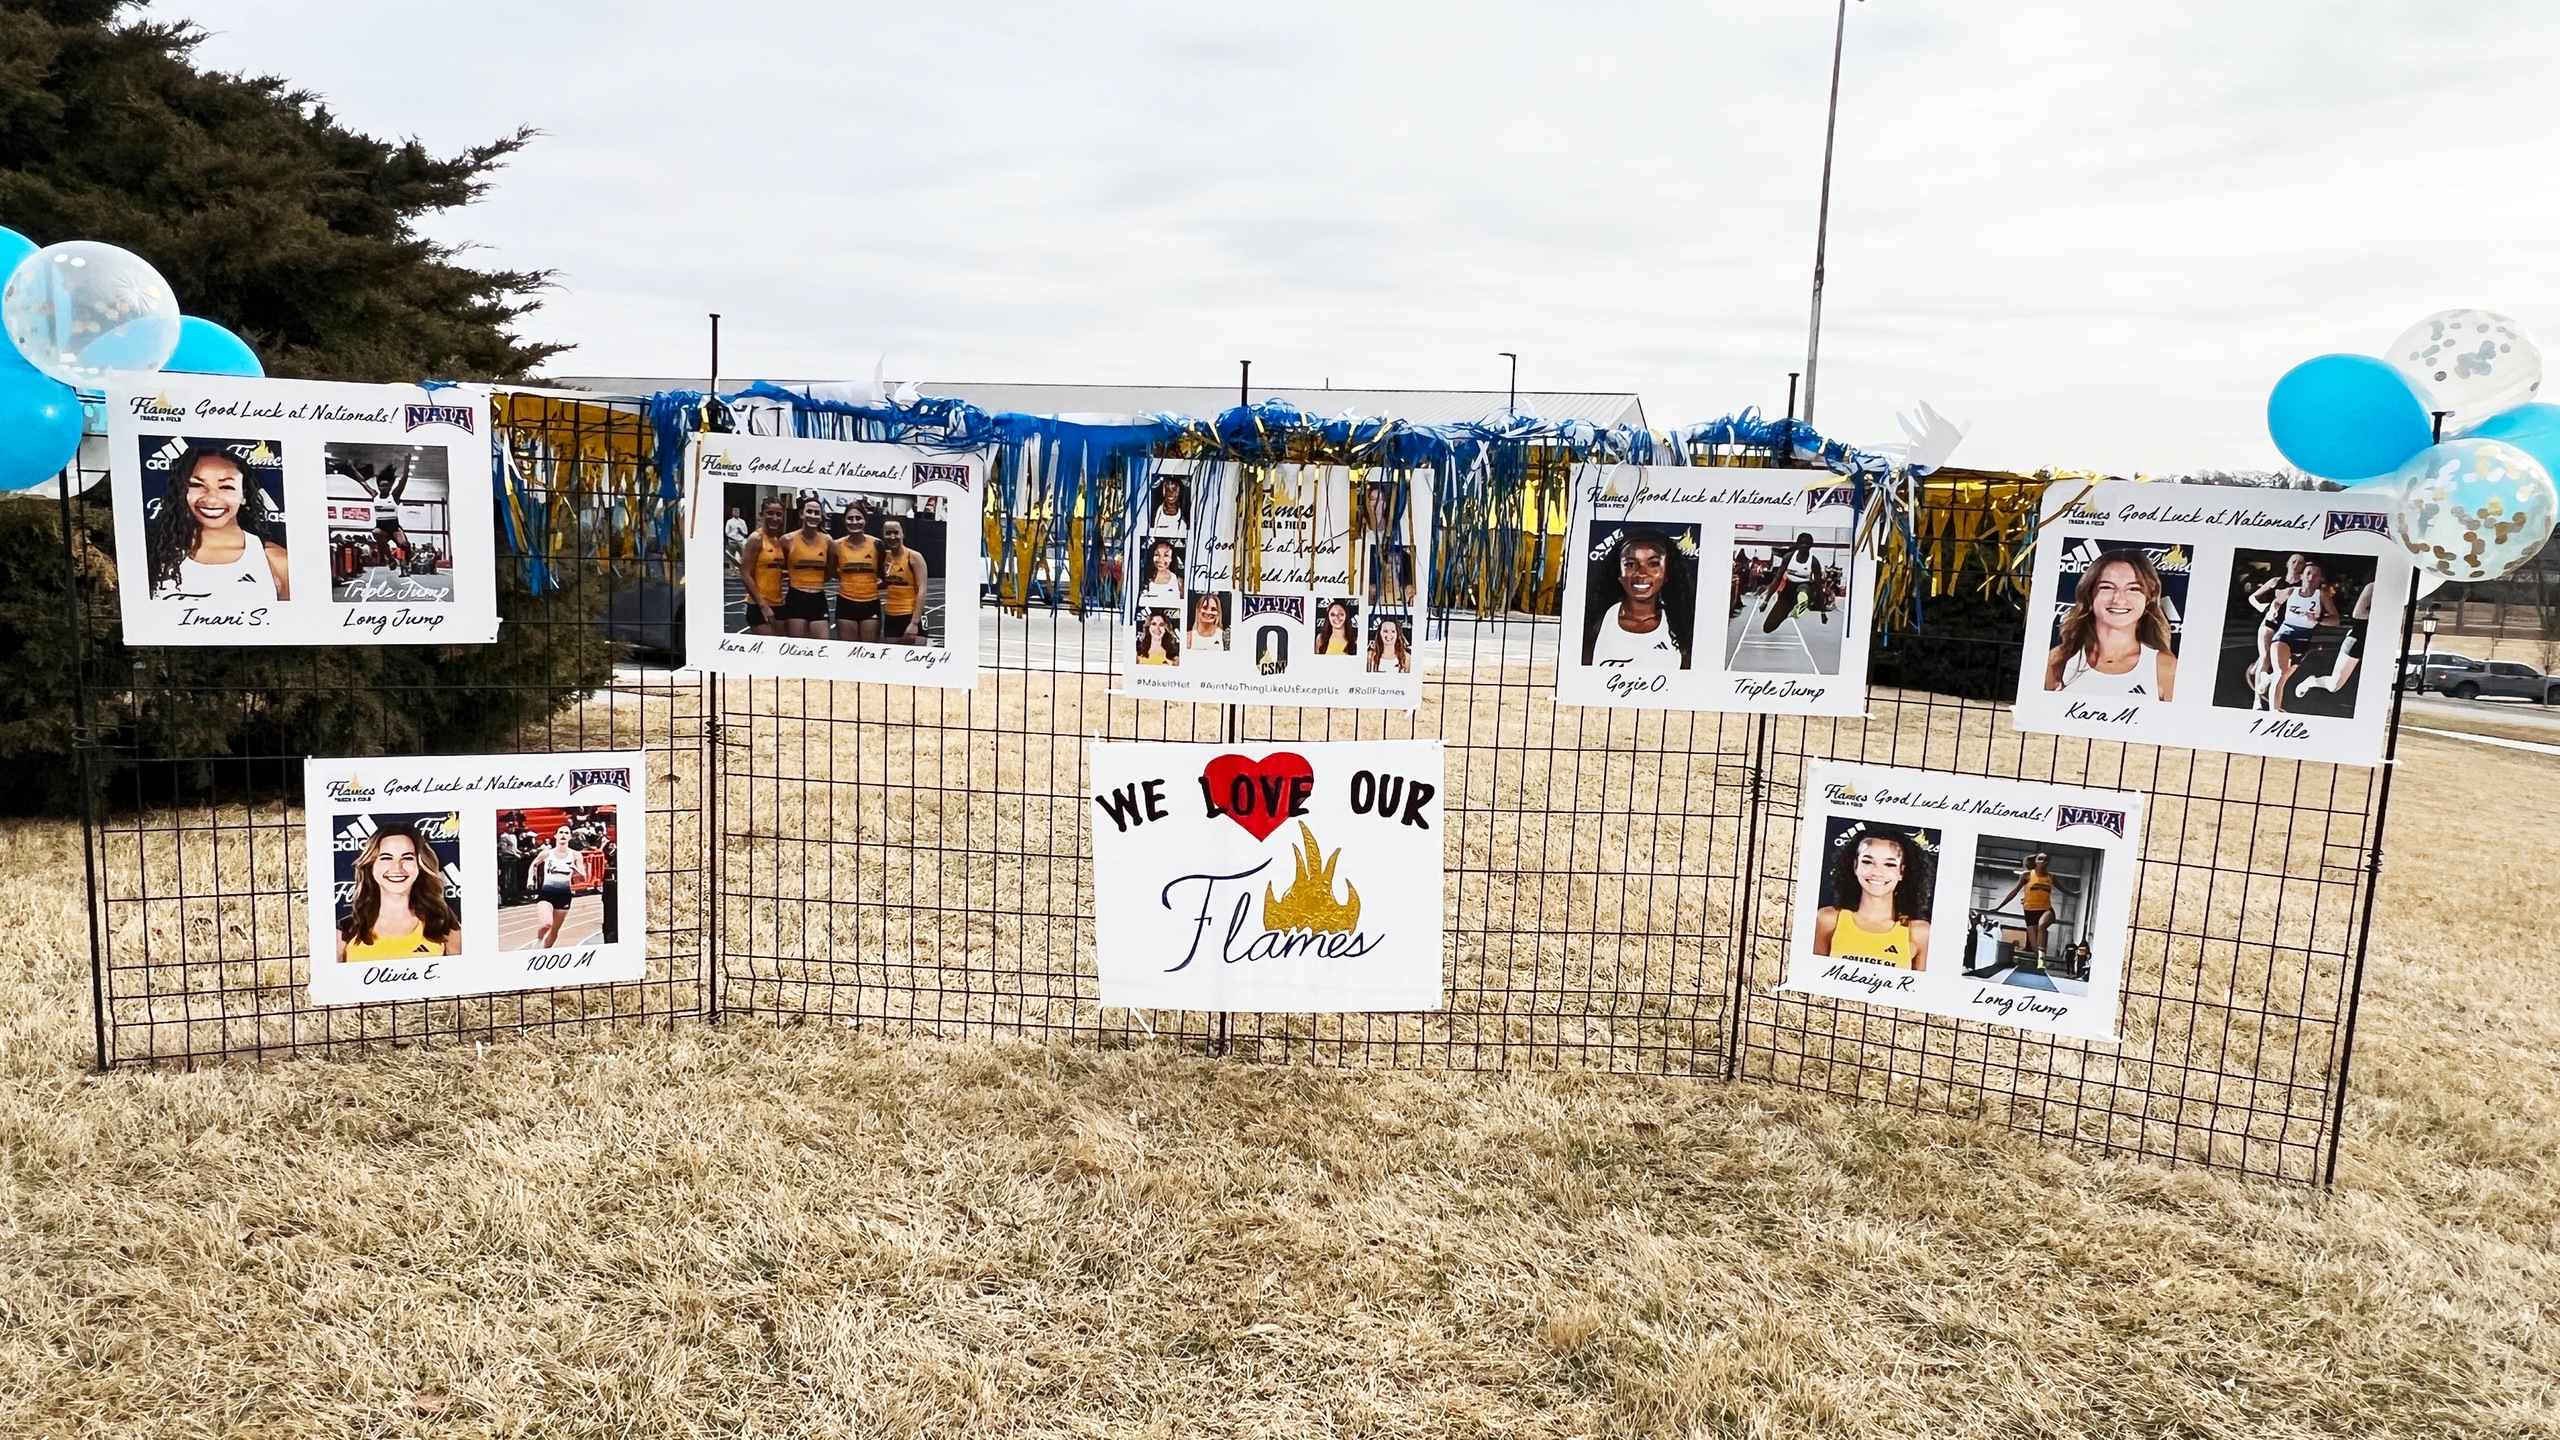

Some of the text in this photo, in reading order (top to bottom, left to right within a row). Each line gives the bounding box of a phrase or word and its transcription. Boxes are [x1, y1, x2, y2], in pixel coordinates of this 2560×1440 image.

[130, 396, 186, 416] Flames
[195, 398, 398, 425] Good Luck at Nationals!
[405, 404, 473, 431] NAIA
[748, 456, 782, 474] Good
[782, 458, 816, 474] Luck
[818, 461, 835, 475] at
[834, 463, 908, 482] Nationals!
[914, 463, 968, 490] NAIA
[1636, 486, 1670, 505] Good
[1671, 487, 1707, 504] Luck
[1710, 490, 1727, 504] at
[1726, 489, 1804, 507] Nationals!
[2118, 503, 2317, 531] Good Luck at Nationals!
[1276, 539, 1291, 553] at
[178, 606, 270, 627] Imani S.
[1243, 595, 1303, 622] NAIA
[342, 607, 445, 636] Long Jump
[718, 638, 747, 655] Kara
[848, 646, 877, 660] Mira
[904, 650, 937, 669] Carly
[1261, 661, 1286, 676] CSM
[1606, 675, 1669, 699] Gozie O.
[1733, 678, 1826, 702] Triple Jump
[2064, 701, 2138, 726] Kara M.
[2249, 718, 2310, 741] 1 Mile
[326, 780, 376, 798] Flames
[383, 773, 565, 797] Good Luck at Nationals!
[571, 768, 630, 792] NAIA
[1095, 770, 1436, 833] WE LOVE OUR
[1875, 788, 2054, 823] Good Luck at Nationals!
[2058, 805, 2125, 836] NAIA
[1161, 857, 1386, 973] Flames
[526, 949, 596, 974] 1000 M
[363, 962, 442, 986] Olivia E.
[1821, 964, 1916, 994] Makaiya R.
[1971, 987, 2068, 1021] Long Jump
